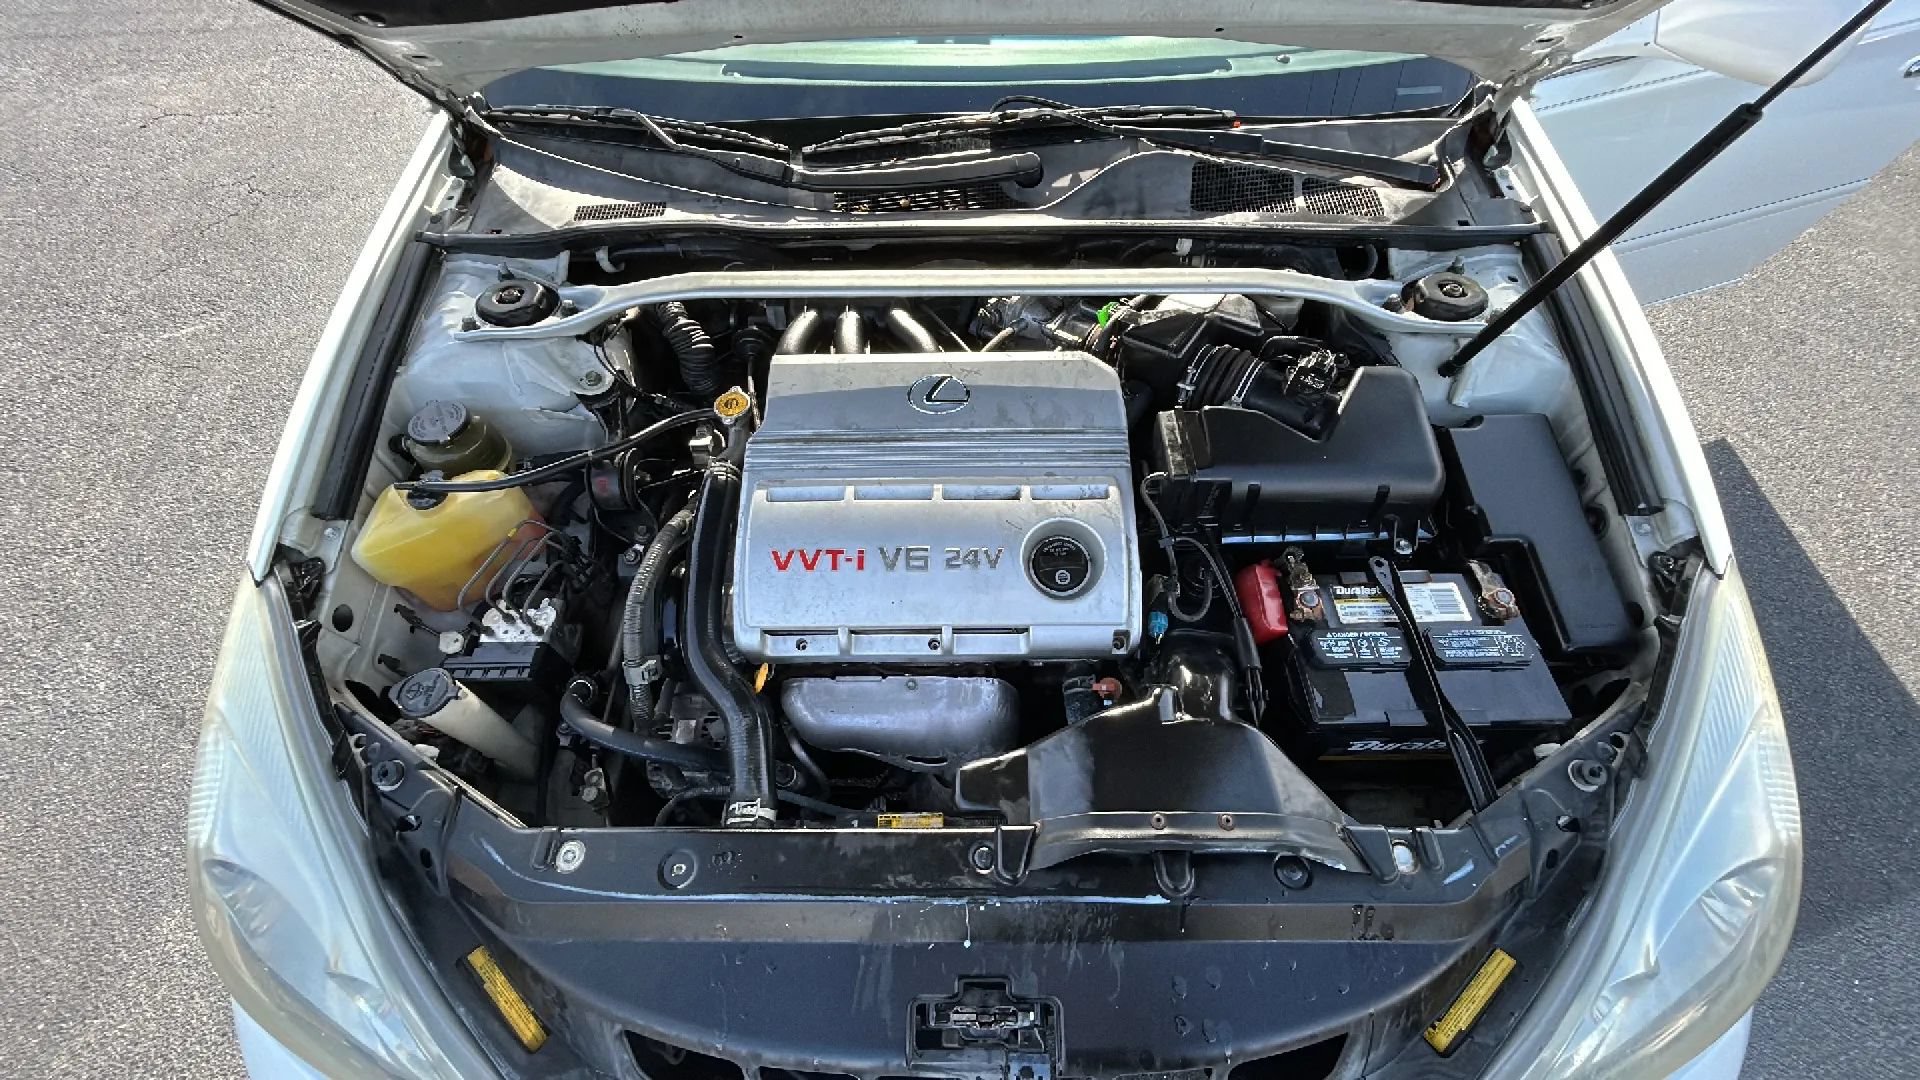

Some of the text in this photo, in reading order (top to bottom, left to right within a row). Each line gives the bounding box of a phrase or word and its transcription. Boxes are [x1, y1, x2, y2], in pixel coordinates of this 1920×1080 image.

[772, 545, 1004, 572] VVT-i V6 24V
[1333, 585, 1382, 595] Duralast
